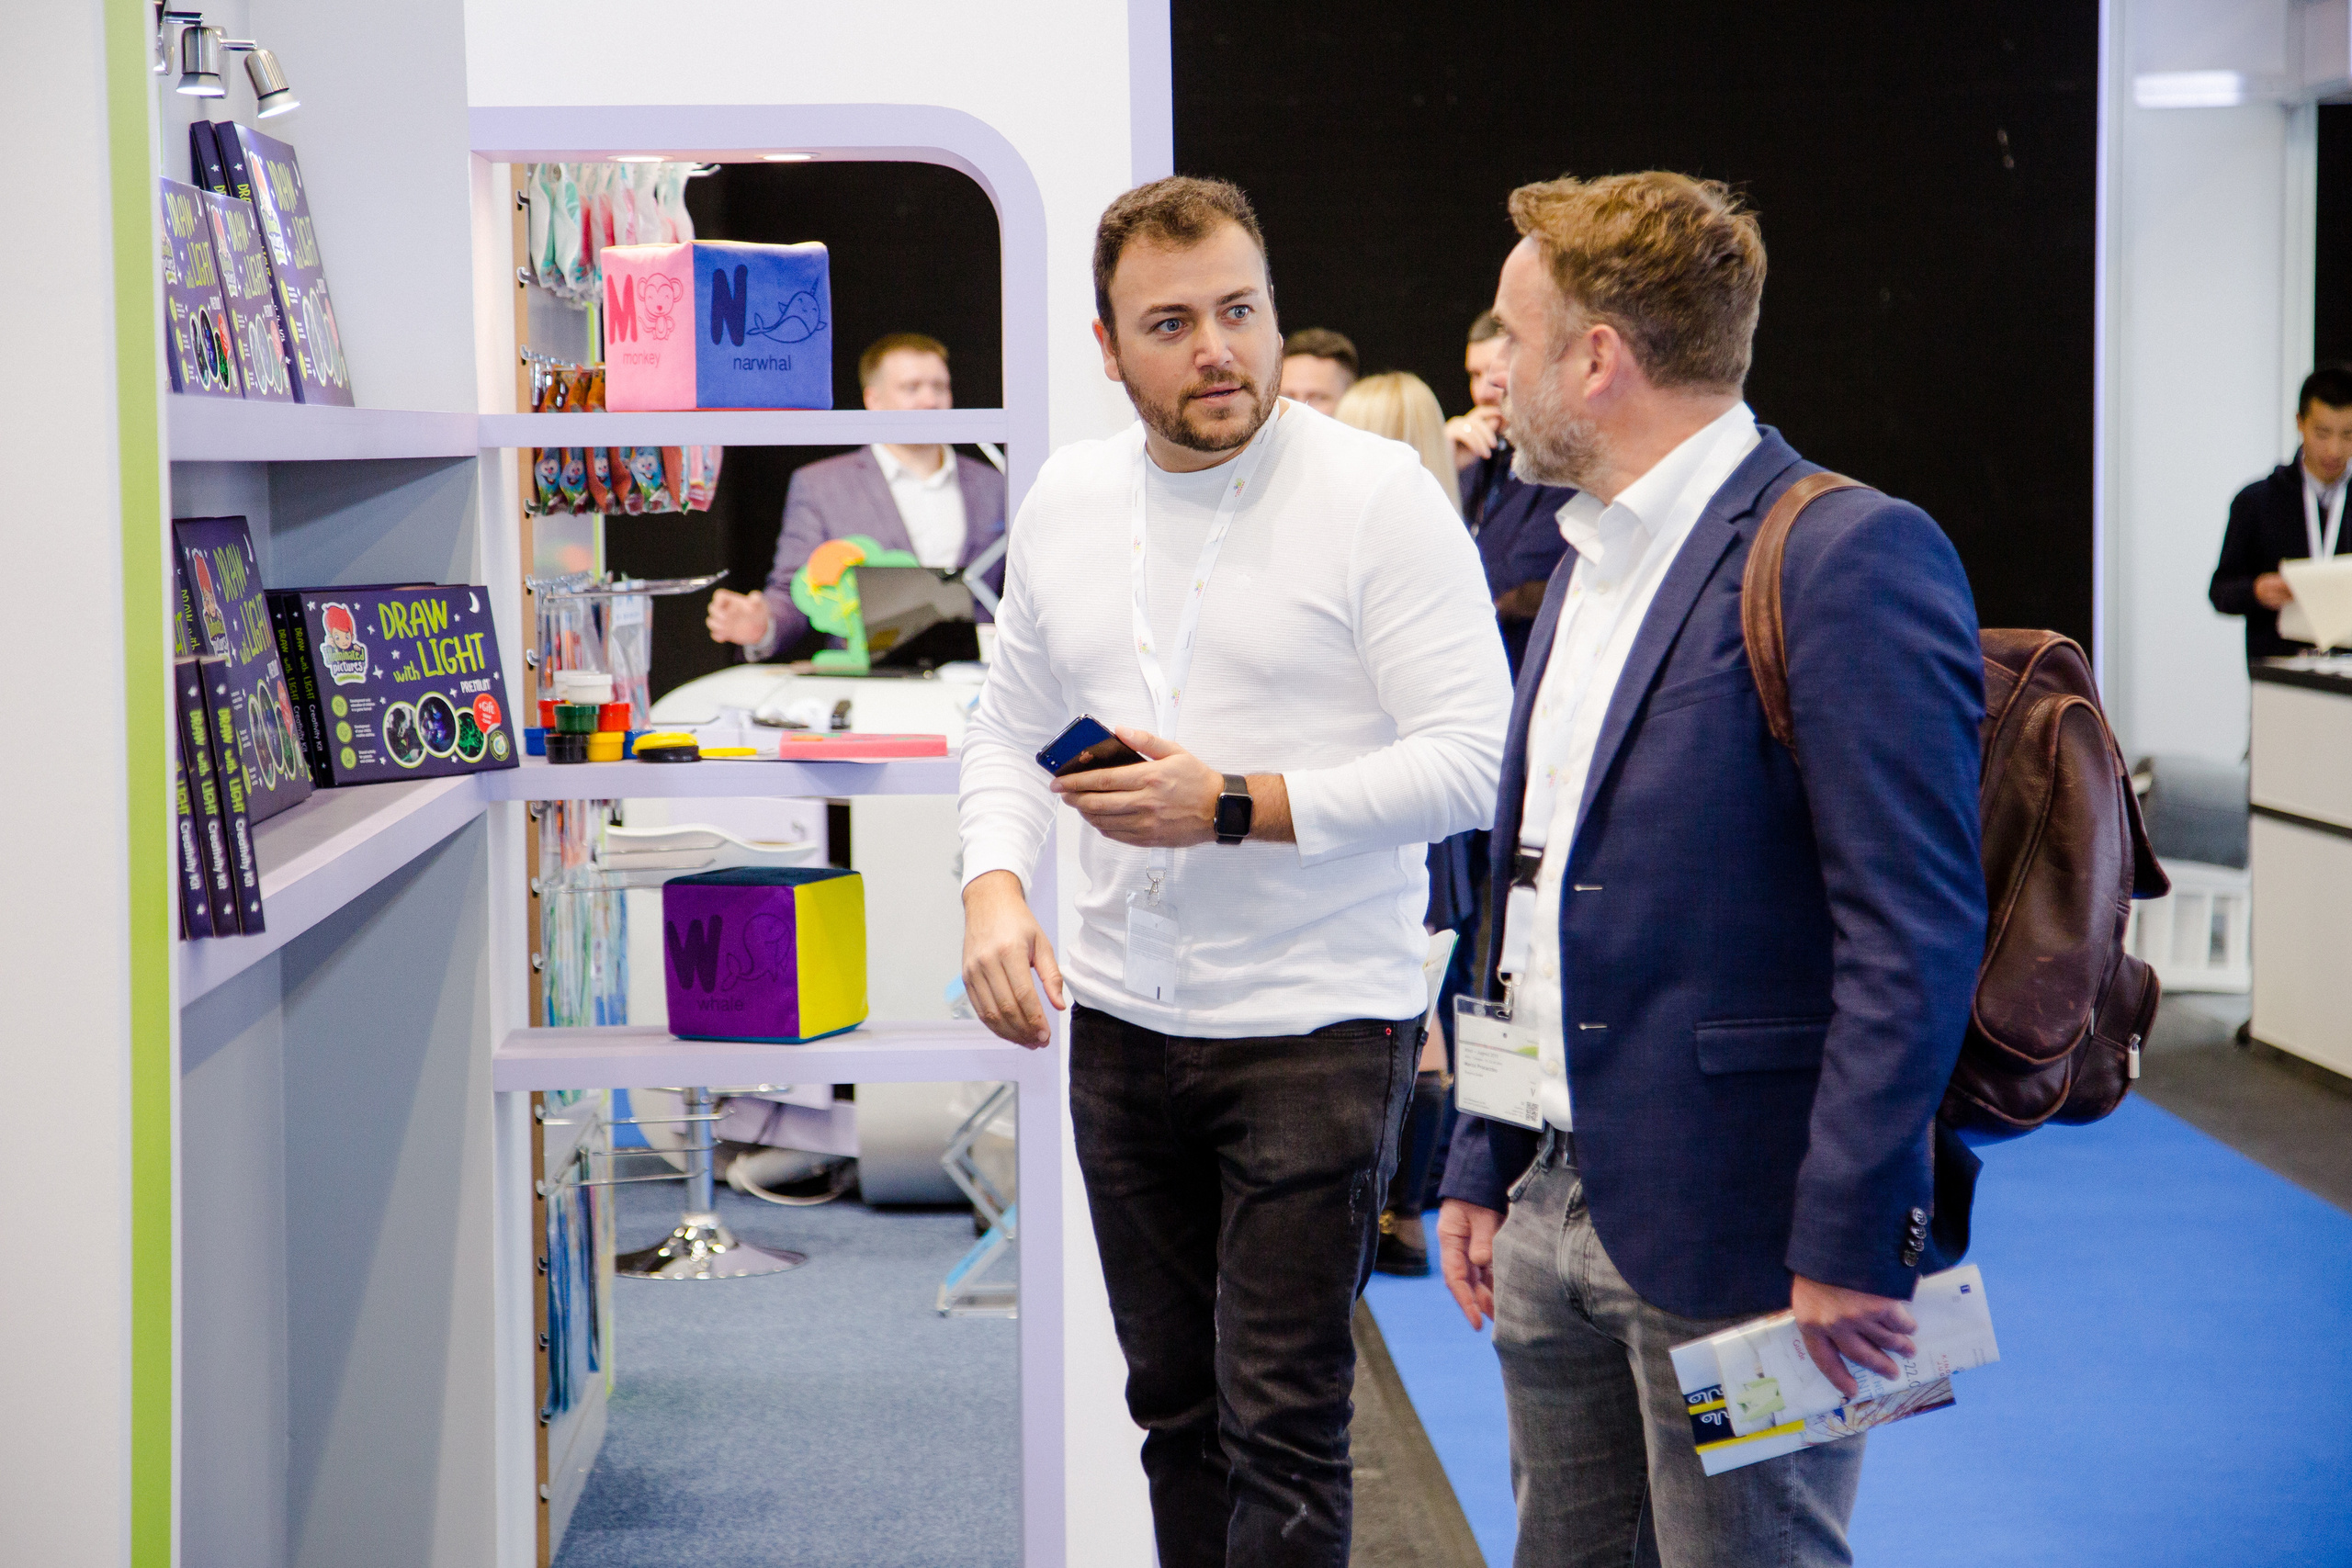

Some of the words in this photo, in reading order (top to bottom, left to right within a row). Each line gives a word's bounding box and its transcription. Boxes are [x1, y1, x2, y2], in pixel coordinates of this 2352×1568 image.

[266, 160, 298, 213] DRAW
[165, 192, 195, 240] DRAW
[225, 210, 249, 253] DRAW
[291, 216, 320, 268] LIGHT
[187, 242, 216, 287] LIGHT
[243, 254, 268, 296] LIGHT
[606, 274, 638, 345] M
[710, 264, 748, 347] N
[623, 353, 661, 368] monkey
[733, 354, 792, 371] narwhal
[212, 543, 247, 604] DRAW
[239, 592, 272, 658] LIGHT
[379, 598, 447, 640] DRAW
[294, 627, 305, 652] DRAW
[393, 660, 421, 682] with
[416, 632, 486, 677] LIGHT
[277, 628, 288, 653] DRAW
[283, 657, 293, 674] with
[288, 676, 300, 701] LIGHT
[300, 656, 310, 672] with
[333, 661, 365, 675] pictures
[303, 676, 315, 701] LIGHT
[189, 709, 205, 745] DRAW
[218, 708, 232, 744] DRAW
[309, 704, 322, 740] Creativity
[197, 750, 210, 776] with
[224, 749, 239, 775] with
[201, 780, 219, 815] LIGHT
[229, 777, 246, 814] LIGHT
[180, 821, 198, 874] Creativity
[189, 874, 200, 890] Kit
[209, 821, 225, 874] Creativity
[235, 818, 253, 871] Creativity
[217, 874, 228, 890] Kit
[243, 870, 254, 887] Kit
[666, 914, 723, 994] W
[697, 997, 744, 1011] whale
[1792, 1338, 1805, 1361] Guide
